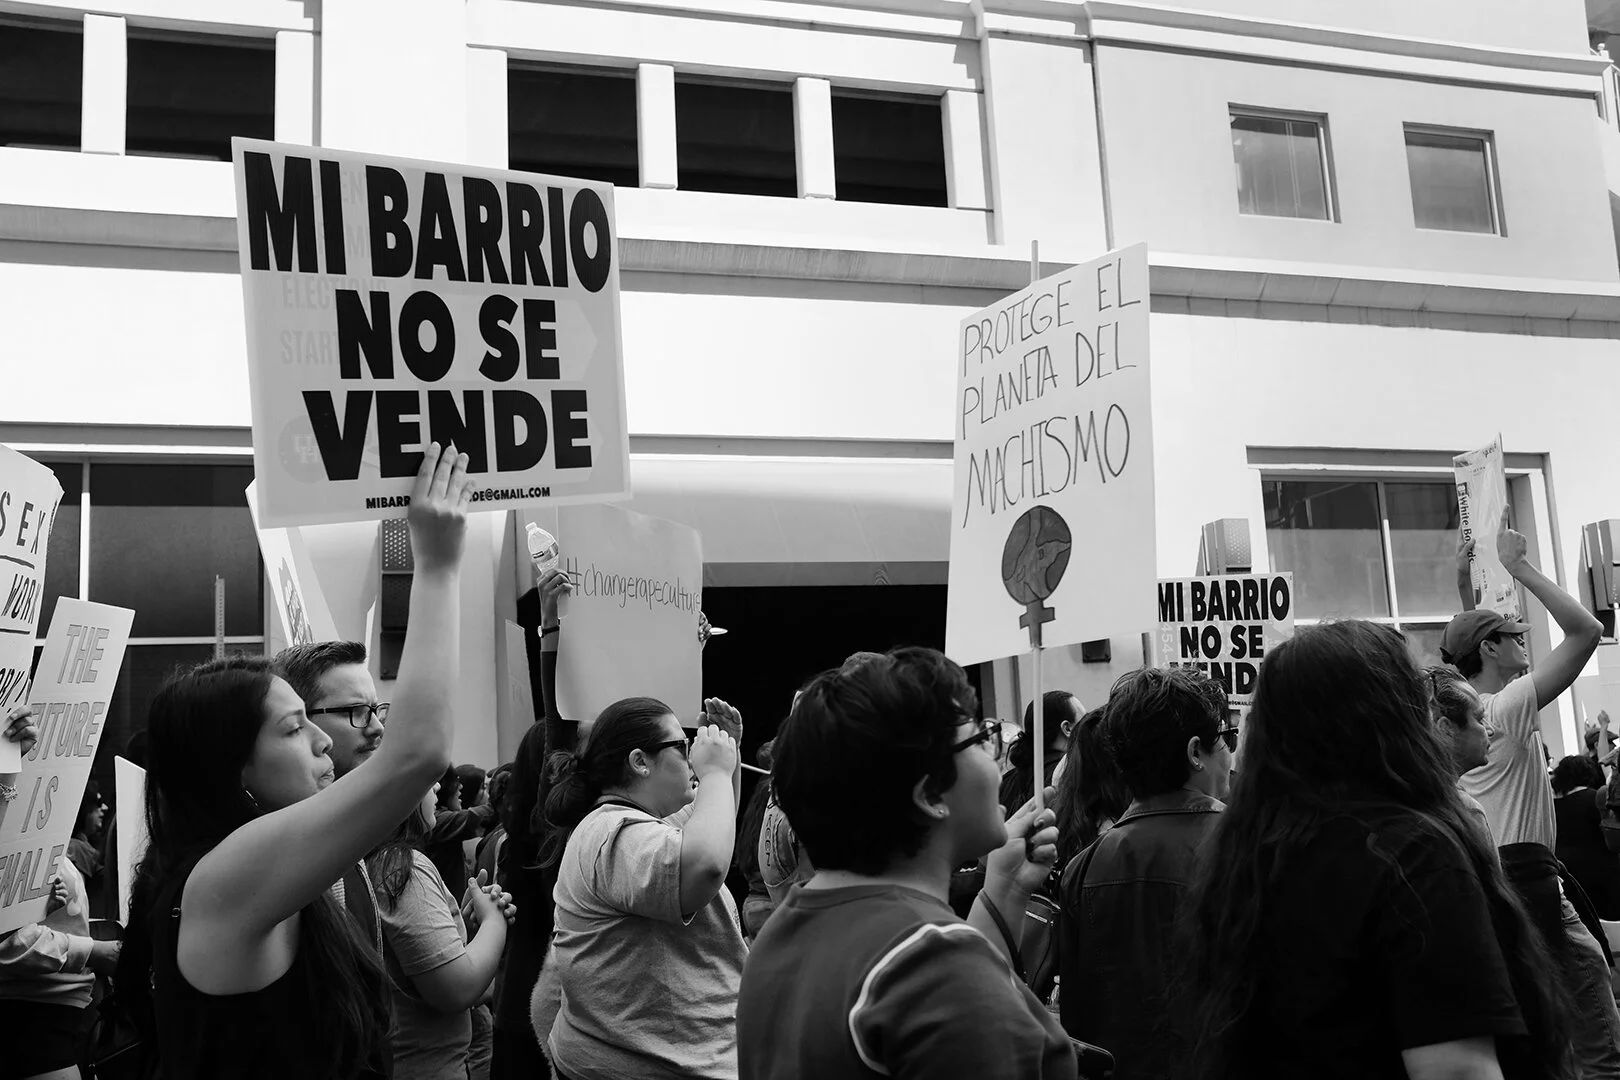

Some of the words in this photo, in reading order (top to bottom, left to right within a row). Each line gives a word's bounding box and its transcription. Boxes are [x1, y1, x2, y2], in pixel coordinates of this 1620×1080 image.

[244, 151, 347, 275] MI
[365, 165, 611, 293] BARRIO
[335, 289, 456, 382] NO
[478, 294, 560, 383] SE
[963, 280, 1073, 377] PROTEGE
[1098, 258, 1141, 312] EL
[963, 346, 1058, 440] PLANETA
[1076, 321, 1136, 387] DEL
[301, 390, 593, 482] VENDE
[962, 403, 1130, 528] MACHISMO
[0, 490, 46, 555] SEX
[1459, 496, 1470, 526] White
[566, 557, 701, 615] #changerapeculture
[1158, 582, 1184, 622] MI
[1190, 576, 1290, 621] BARRIO
[57, 624, 110, 684] THE
[1180, 625, 1222, 659] NO
[1230, 624, 1264, 659] SE
[21, 776, 59, 833] IS
